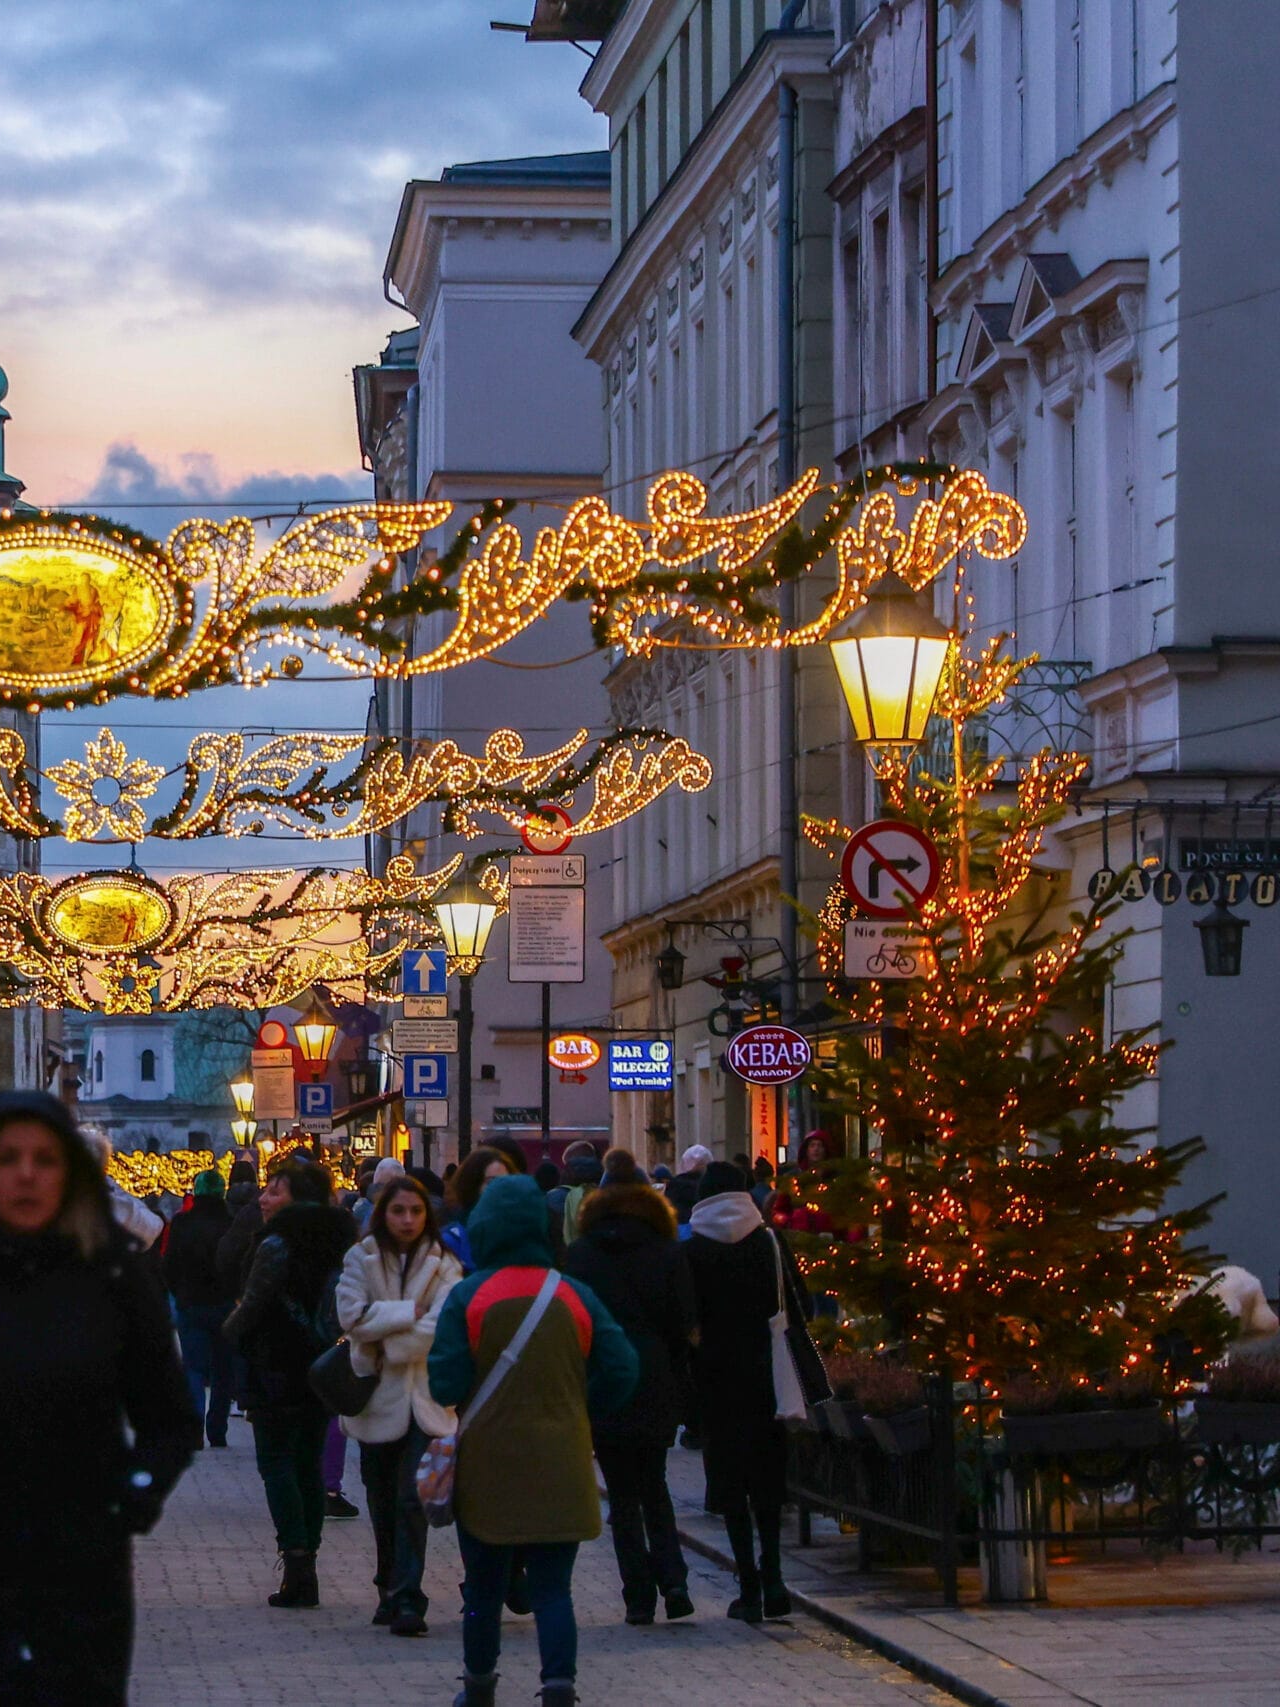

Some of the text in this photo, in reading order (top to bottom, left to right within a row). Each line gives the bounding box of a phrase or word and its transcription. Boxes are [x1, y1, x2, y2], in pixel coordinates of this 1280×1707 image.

[854, 926, 876, 938] Nie
[555, 1040, 593, 1055] BAR
[612, 1045, 643, 1058] BAR
[734, 1042, 807, 1067] KEBAB
[612, 1061, 670, 1073] MLECZNY
[748, 1069, 792, 1077] FARAON
[413, 1059, 438, 1094] P
[307, 1087, 326, 1112] P
